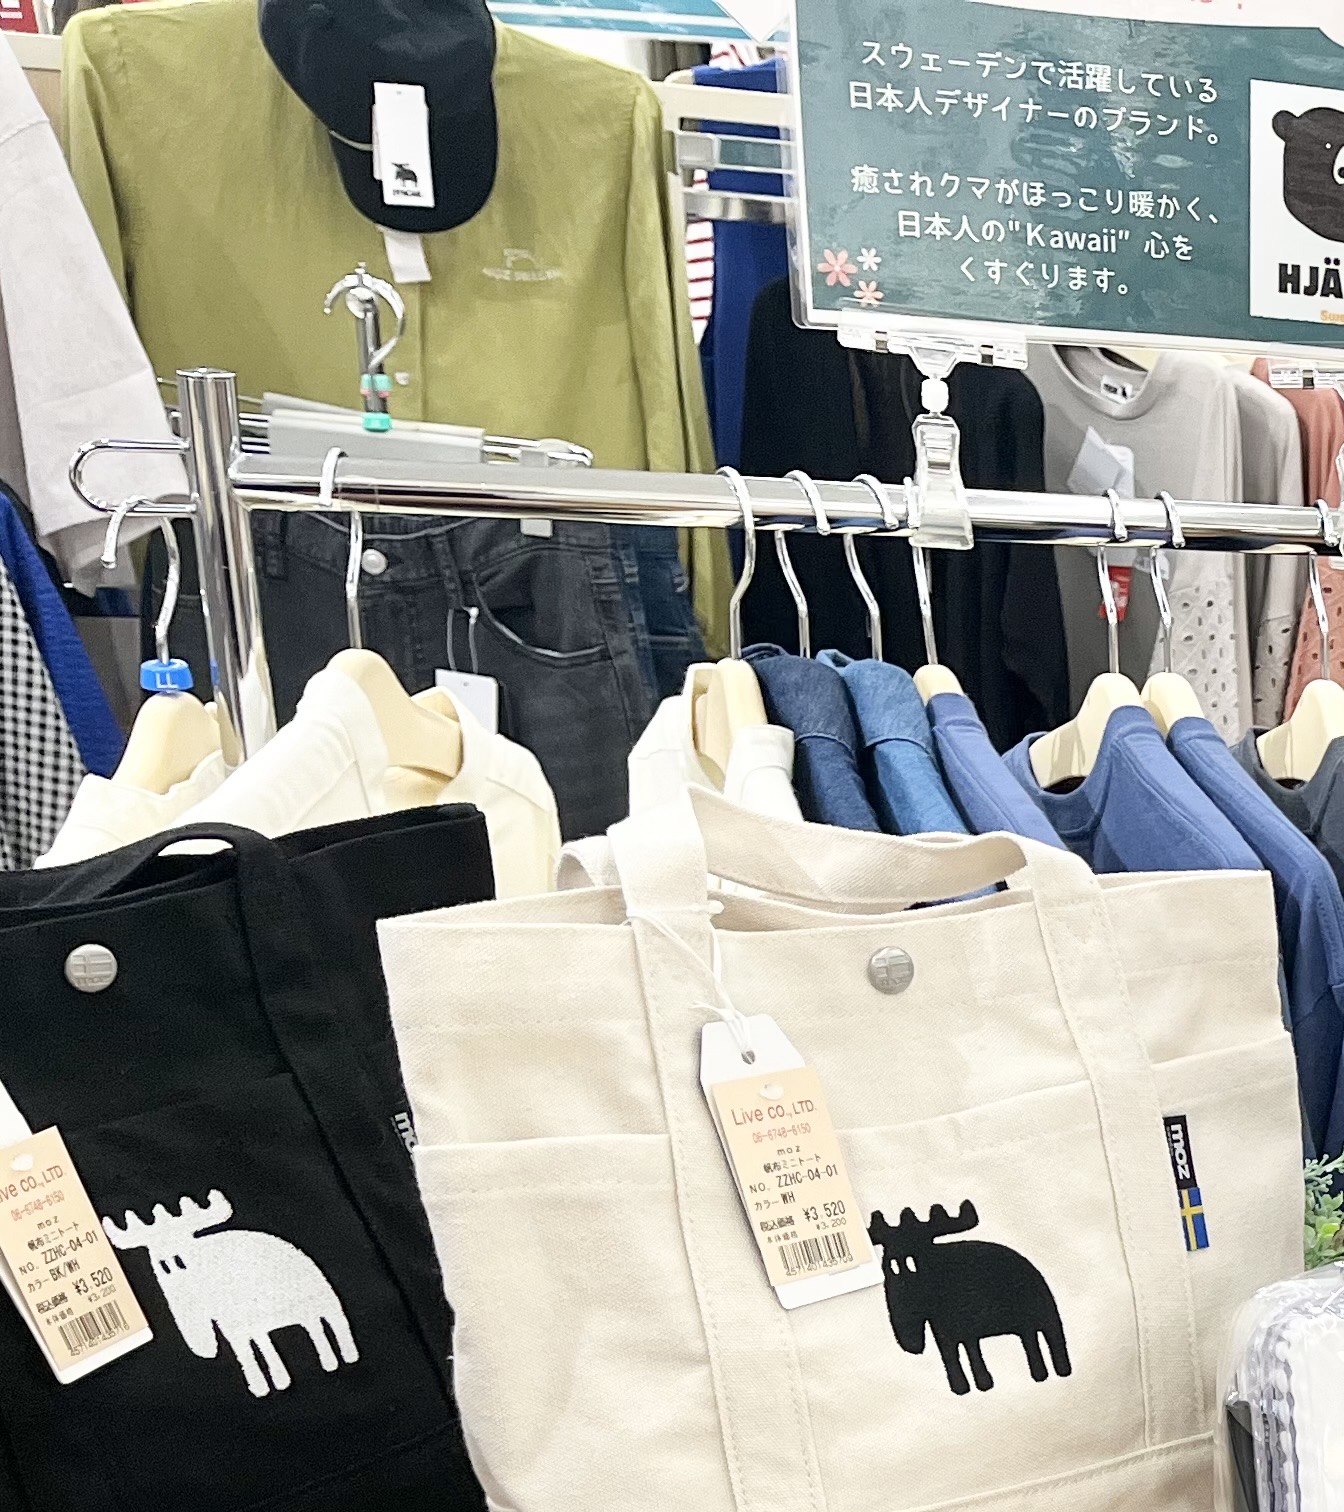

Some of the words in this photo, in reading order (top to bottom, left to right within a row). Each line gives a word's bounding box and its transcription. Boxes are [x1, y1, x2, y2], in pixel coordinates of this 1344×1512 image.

[861, 40, 1219, 103] スウェーデンで活躍している
[848, 81, 1219, 145] 日本人デザイナーのブランド。
[850, 164, 1219, 224] 癒されクマがほっこり暖かく、
[959, 256, 1129, 295] くすぐります。
[156, 673, 179, 689] LL
[731, 1108, 764, 1126] Live
[752, 1122, 812, 1145] 06-6748-6150
[1170, 1123, 1191, 1180] moz
[775, 1164, 839, 1189] ZZHC-04-01
